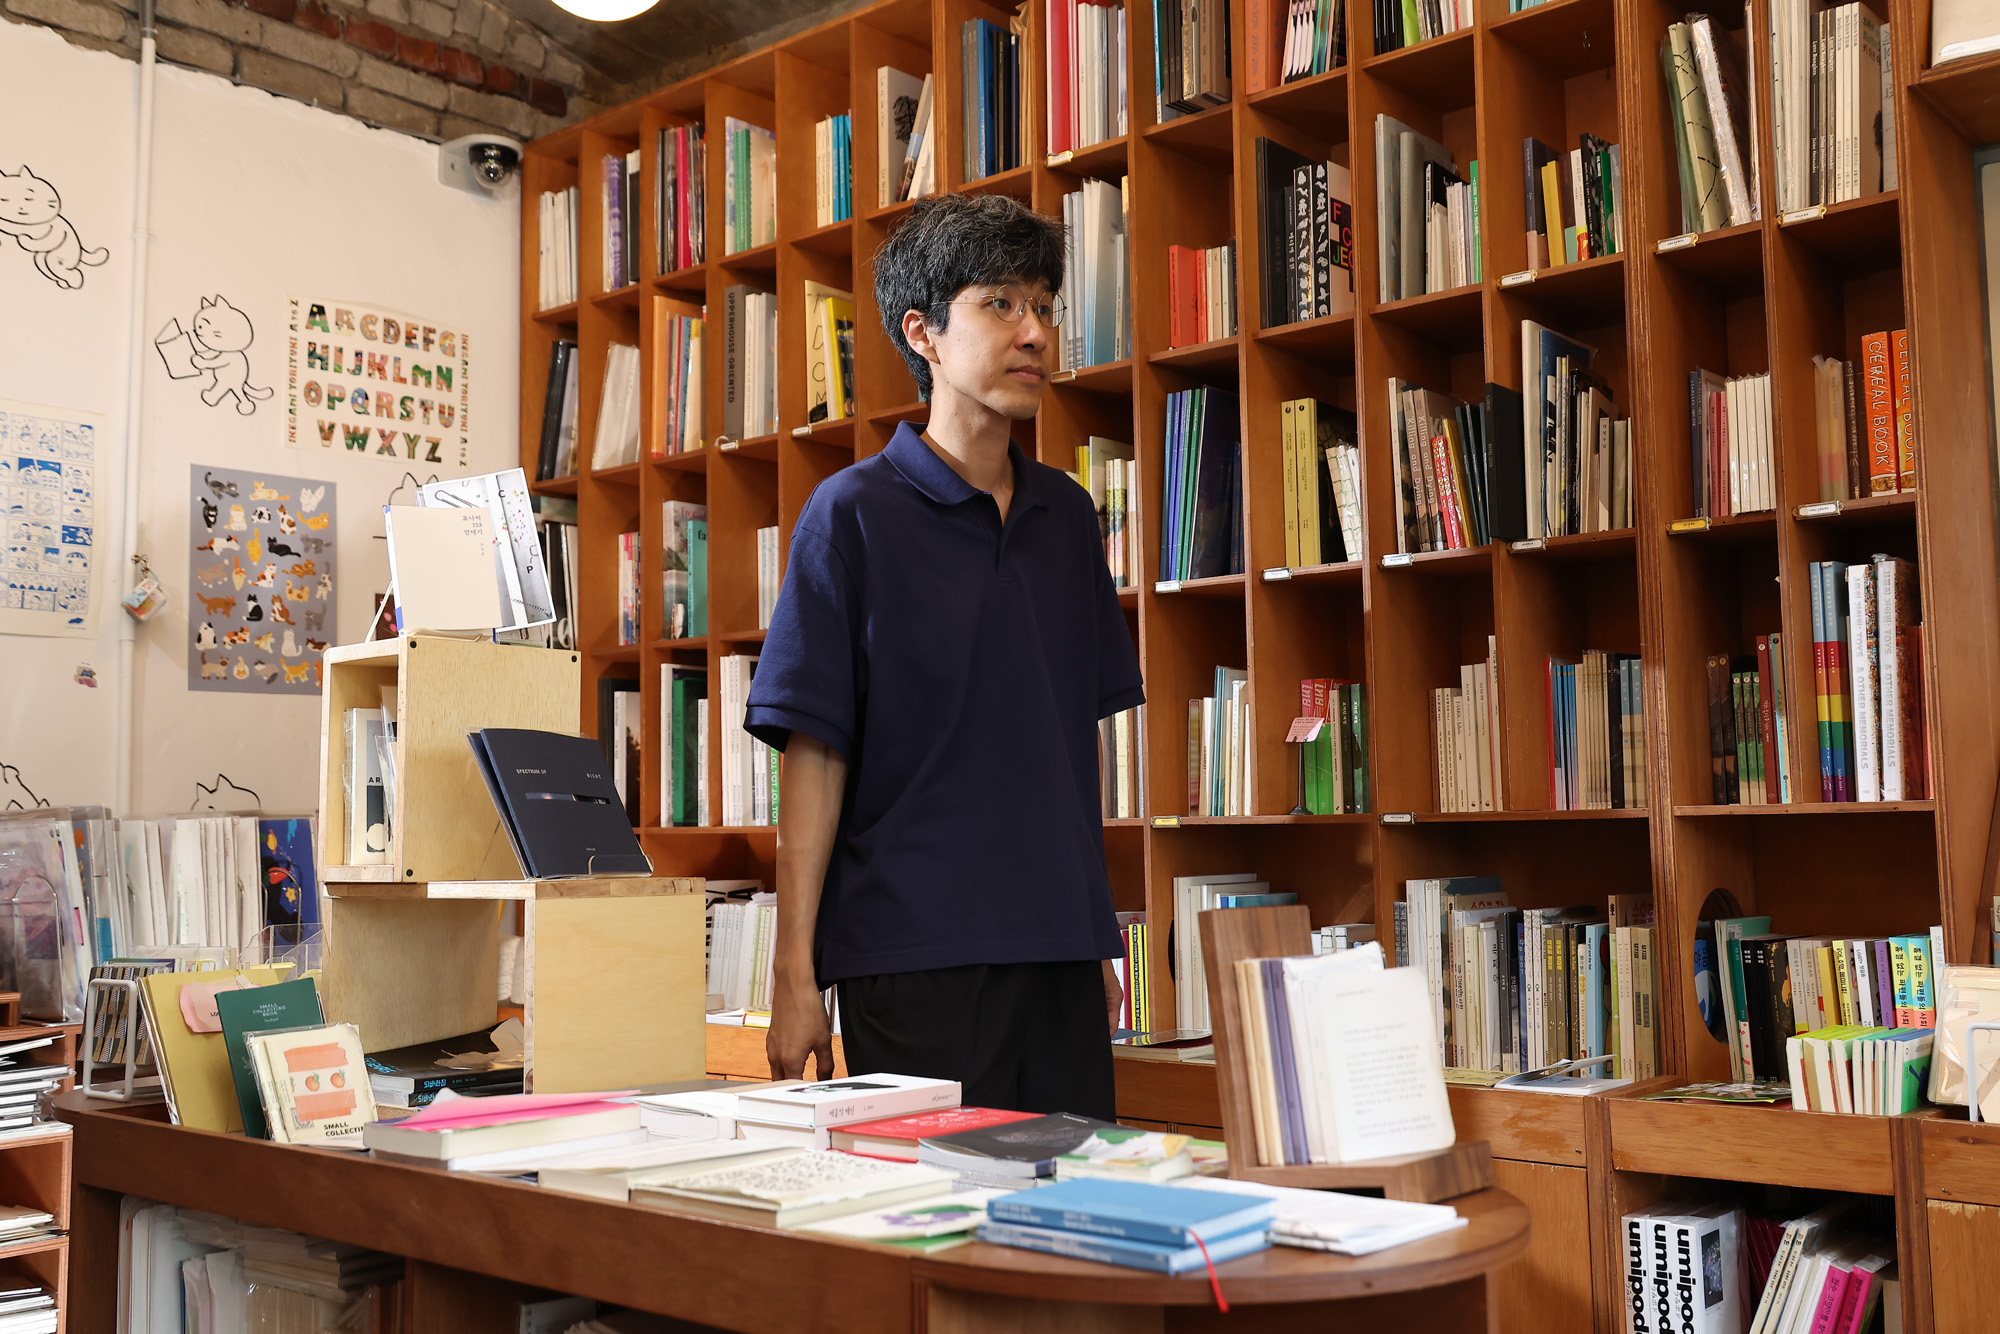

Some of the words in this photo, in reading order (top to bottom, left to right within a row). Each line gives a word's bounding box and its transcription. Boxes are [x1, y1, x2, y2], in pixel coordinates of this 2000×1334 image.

[289, 337, 298, 391] YORIYUKI
[307, 341, 454, 393] HIJKLMN
[1868, 341, 1886, 410] CEREAL
[289, 394, 298, 444] IKEGAMI
[303, 380, 457, 429] OPQRSTU
[317, 420, 443, 463] VWXYZ
[1406, 418, 1419, 449] Killing
[1418, 416, 1431, 447] Killing
[1873, 416, 1889, 466] BOOK
[1411, 454, 1420, 472] and
[1423, 452, 1432, 470] and
[1414, 478, 1424, 506] Dying
[1426, 476, 1437, 504] Dying
[1855, 632, 1863, 657] TOYS
[1883, 630, 1892, 654] TOYS
[1857, 676, 1866, 709] OTHER
[1885, 673, 1894, 707] OTHER
[1857, 710, 1868, 769] MEMORIALS
[1885, 708, 1896, 767] MEMORIALS
[1896, 962, 1905, 977] 없는
[1915, 964, 1924, 978] 없는
[1898, 979, 1908, 1008] 파편들의
[1917, 981, 1926, 1010] 파편들의
[1901, 1010, 1909, 1025] 사회
[1919, 1012, 1927, 1027] 사회
[324, 1122, 349, 1130] SMALL
[1628, 1221, 1649, 1334] umipod
